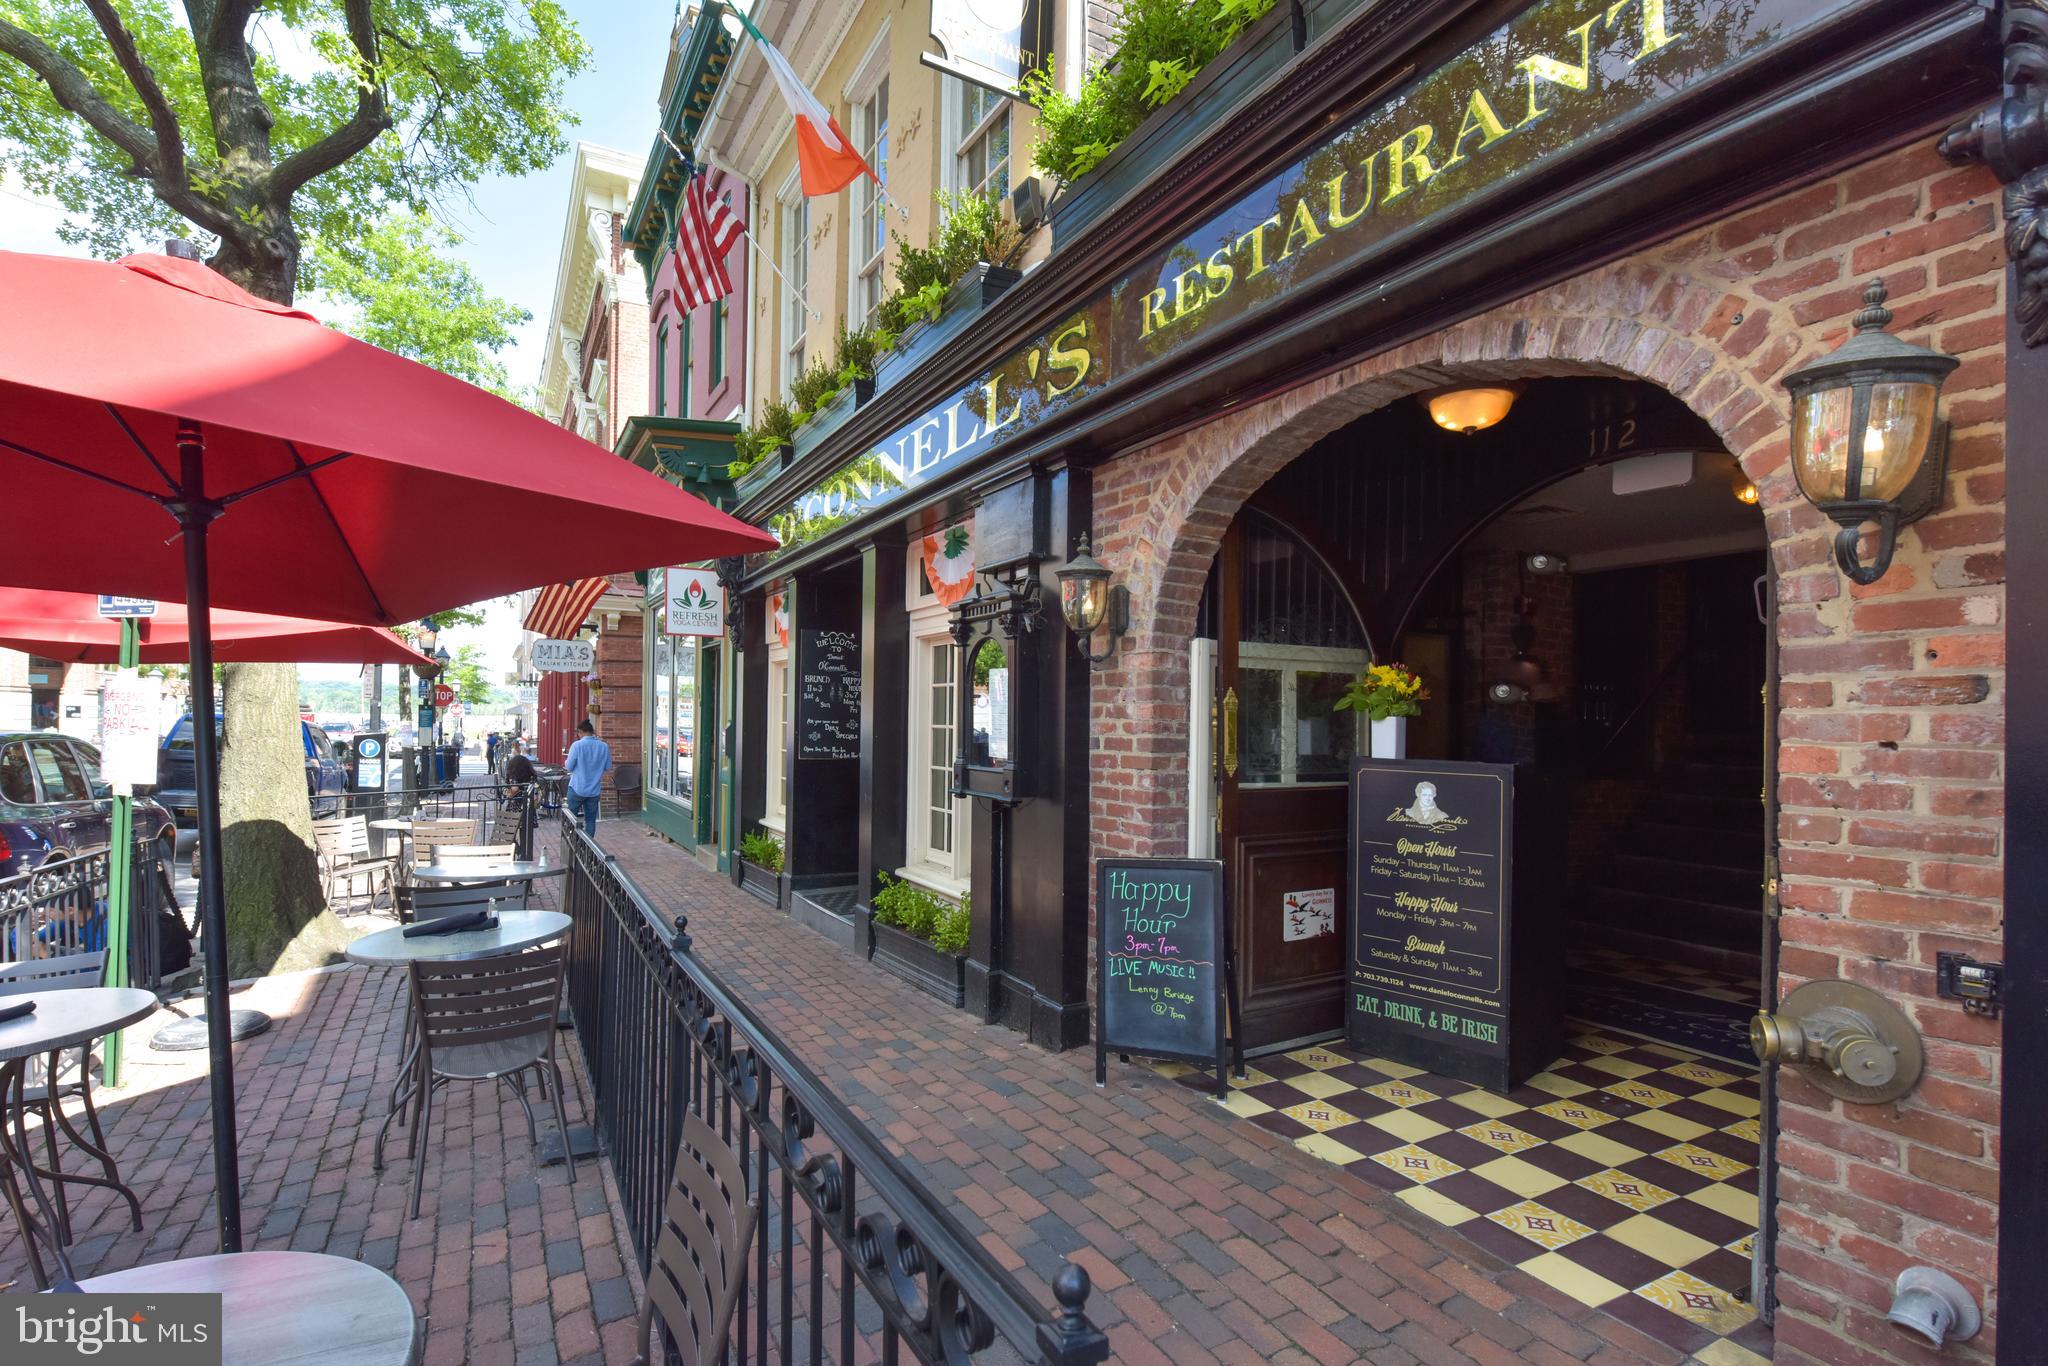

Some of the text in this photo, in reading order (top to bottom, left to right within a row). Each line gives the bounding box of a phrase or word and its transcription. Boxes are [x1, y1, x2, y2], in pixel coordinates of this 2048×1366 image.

[779, 0, 1682, 547] O'CONNELL'S RESTAURANT
[1590, 419, 1636, 457] 112
[672, 610, 718, 621] REFRESH
[692, 620, 718, 628] CENTER
[537, 644, 590, 660] MIA'S
[114, 703, 130, 716] NO
[1397, 837, 1458, 857] Open Hours
[1373, 855, 1400, 866] Sunday
[1407, 858, 1441, 872] Thursday
[1443, 863, 1460, 873] 11AM
[1467, 866, 1482, 875] 1AM
[1370, 865, 1393, 877] Friday
[1399, 869, 1434, 882] Saturday
[1433, 873, 1450, 883] 11AM
[1458, 876, 1485, 888] 1:30AM
[1110, 871, 1192, 919] Happy
[1394, 891, 1459, 913] Happy Hour
[1121, 907, 1177, 934] Hour
[1376, 908, 1407, 921] Monday
[1413, 914, 1437, 927] Friday
[1439, 917, 1455, 928] 3PM
[1462, 921, 1477, 932] 7PM
[1405, 935, 1446, 955] Brunch
[1109, 958, 1143, 977] LIVE
[1148, 961, 1185, 978] MUSIC
[1370, 948, 1402, 963] Saturday
[1402, 954, 1409, 963] &
[1410, 956, 1439, 970] Sunday
[1442, 962, 1460, 973] 11AM
[1467, 967, 1483, 977] 3PM
[1128, 977, 1159, 1000] Lenny
[1362, 972, 1404, 987] 703.739.1124
[1408, 982, 1500, 1007] www.danieloconnells.com
[1169, 1006, 1186, 1020] 7pm
[1356, 994, 1499, 1044] EAT, DRINK, & BE IRISH
